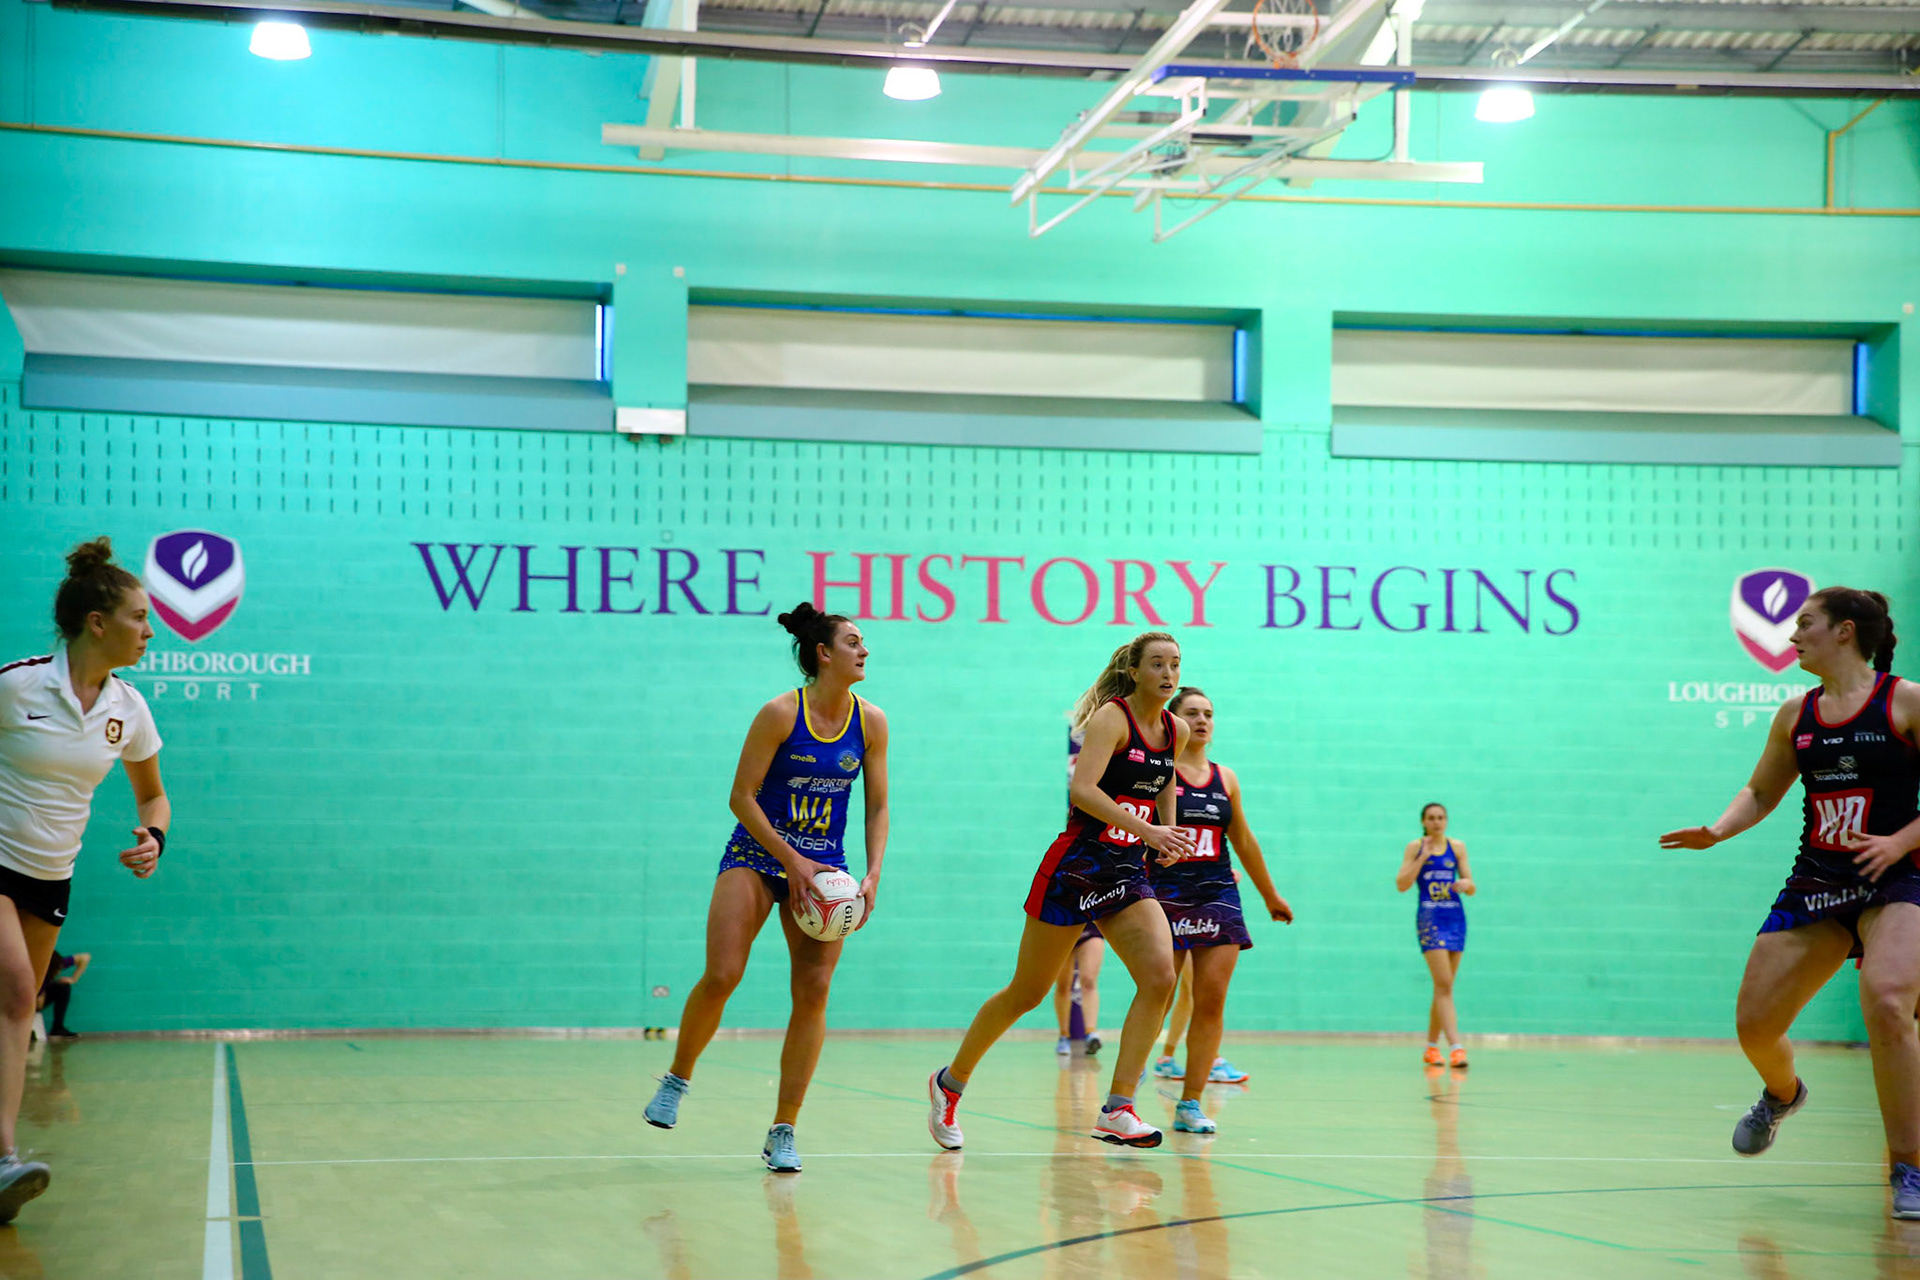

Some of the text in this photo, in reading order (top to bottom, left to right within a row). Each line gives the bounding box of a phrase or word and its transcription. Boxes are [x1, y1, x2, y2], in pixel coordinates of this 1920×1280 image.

[410, 542, 1580, 636] WHERE HISTORY BEGINS
[130, 652, 311, 675] HBOROUGH
[152, 681, 263, 701] PORT
[1668, 681, 1806, 703] LOUGHBOR
[786, 794, 832, 837] WA
[1080, 885, 1127, 911] Vity
[841, 904, 853, 935] GILB
[1172, 917, 1220, 938] Vitality
